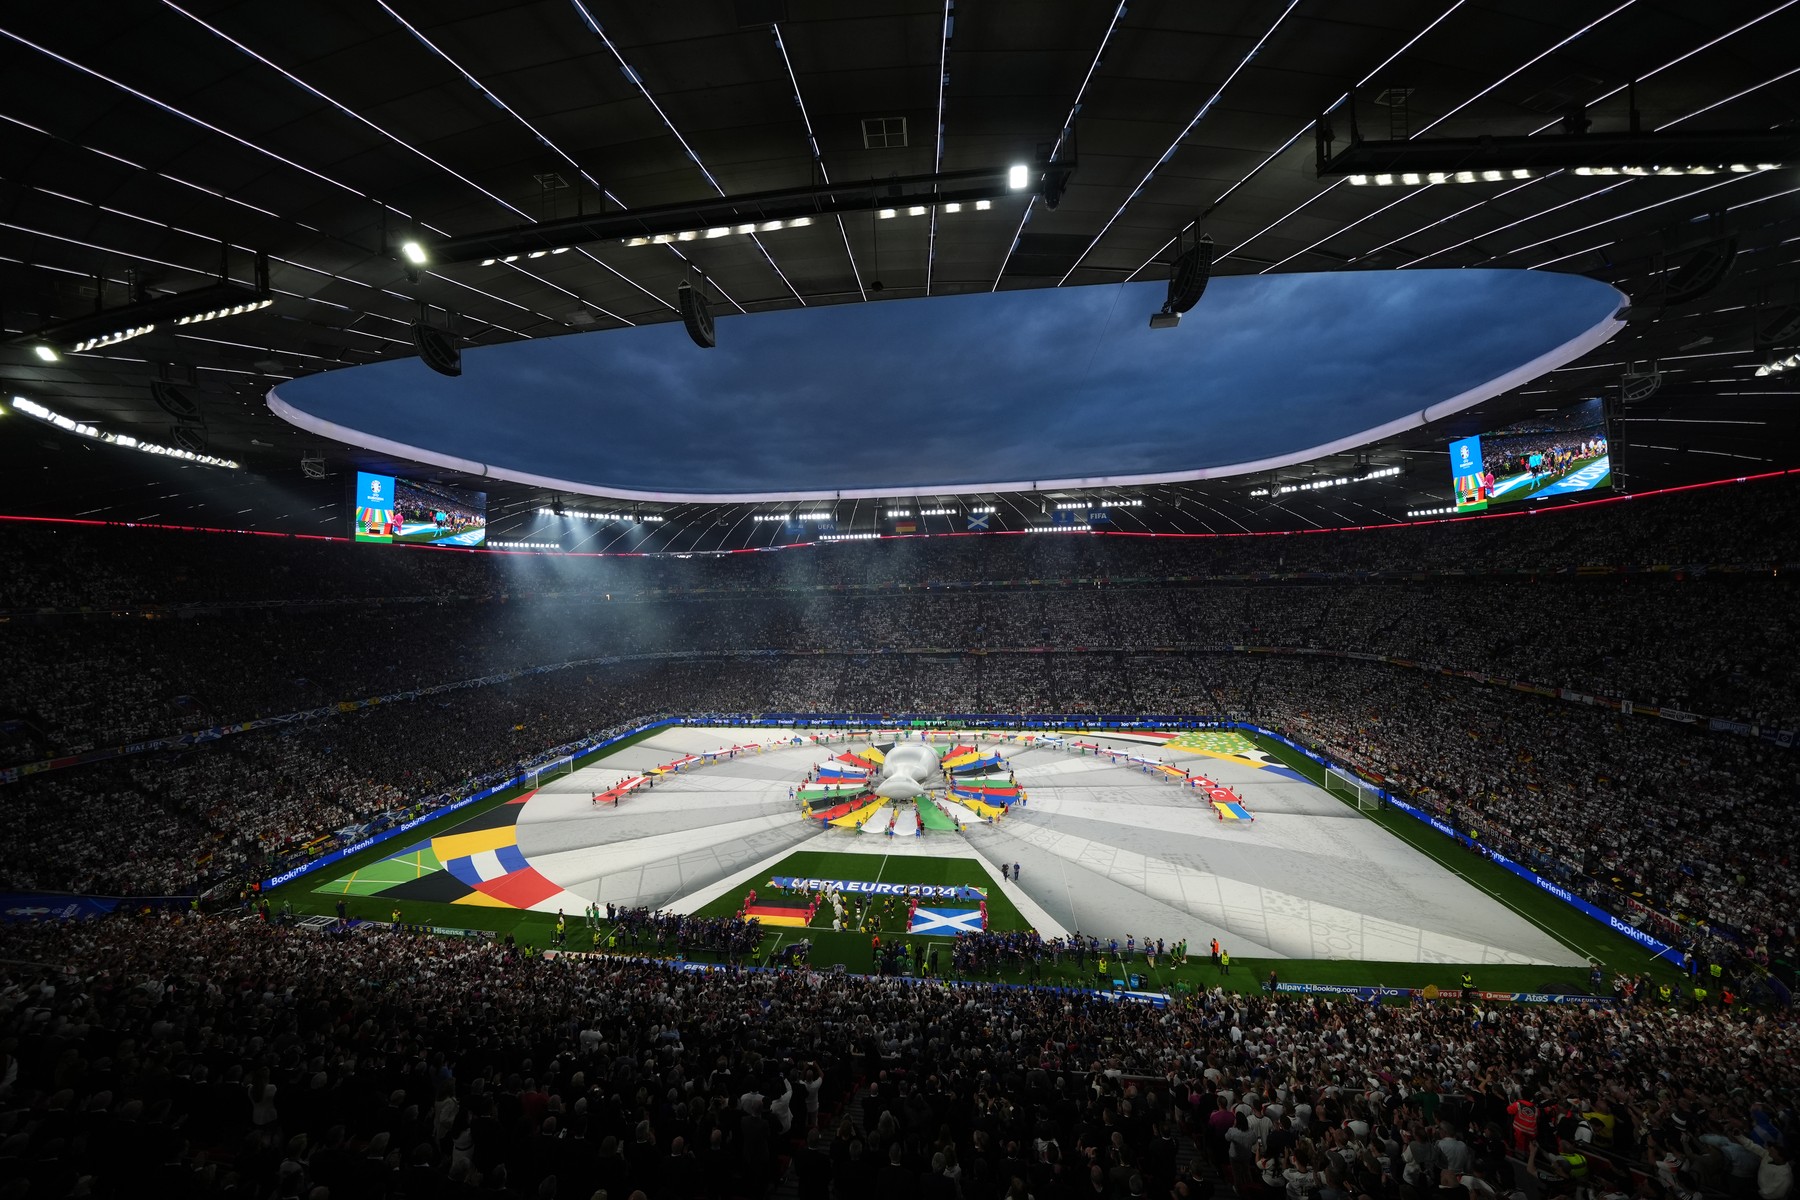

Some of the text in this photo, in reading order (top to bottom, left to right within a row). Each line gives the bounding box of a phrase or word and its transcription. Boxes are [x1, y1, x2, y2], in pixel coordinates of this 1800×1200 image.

[1090, 512, 1107, 520] FIFA
[433, 927, 464, 936] Hisense
[1276, 982, 1302, 992] Alipay
[1312, 984, 1358, 994] Booking.com
